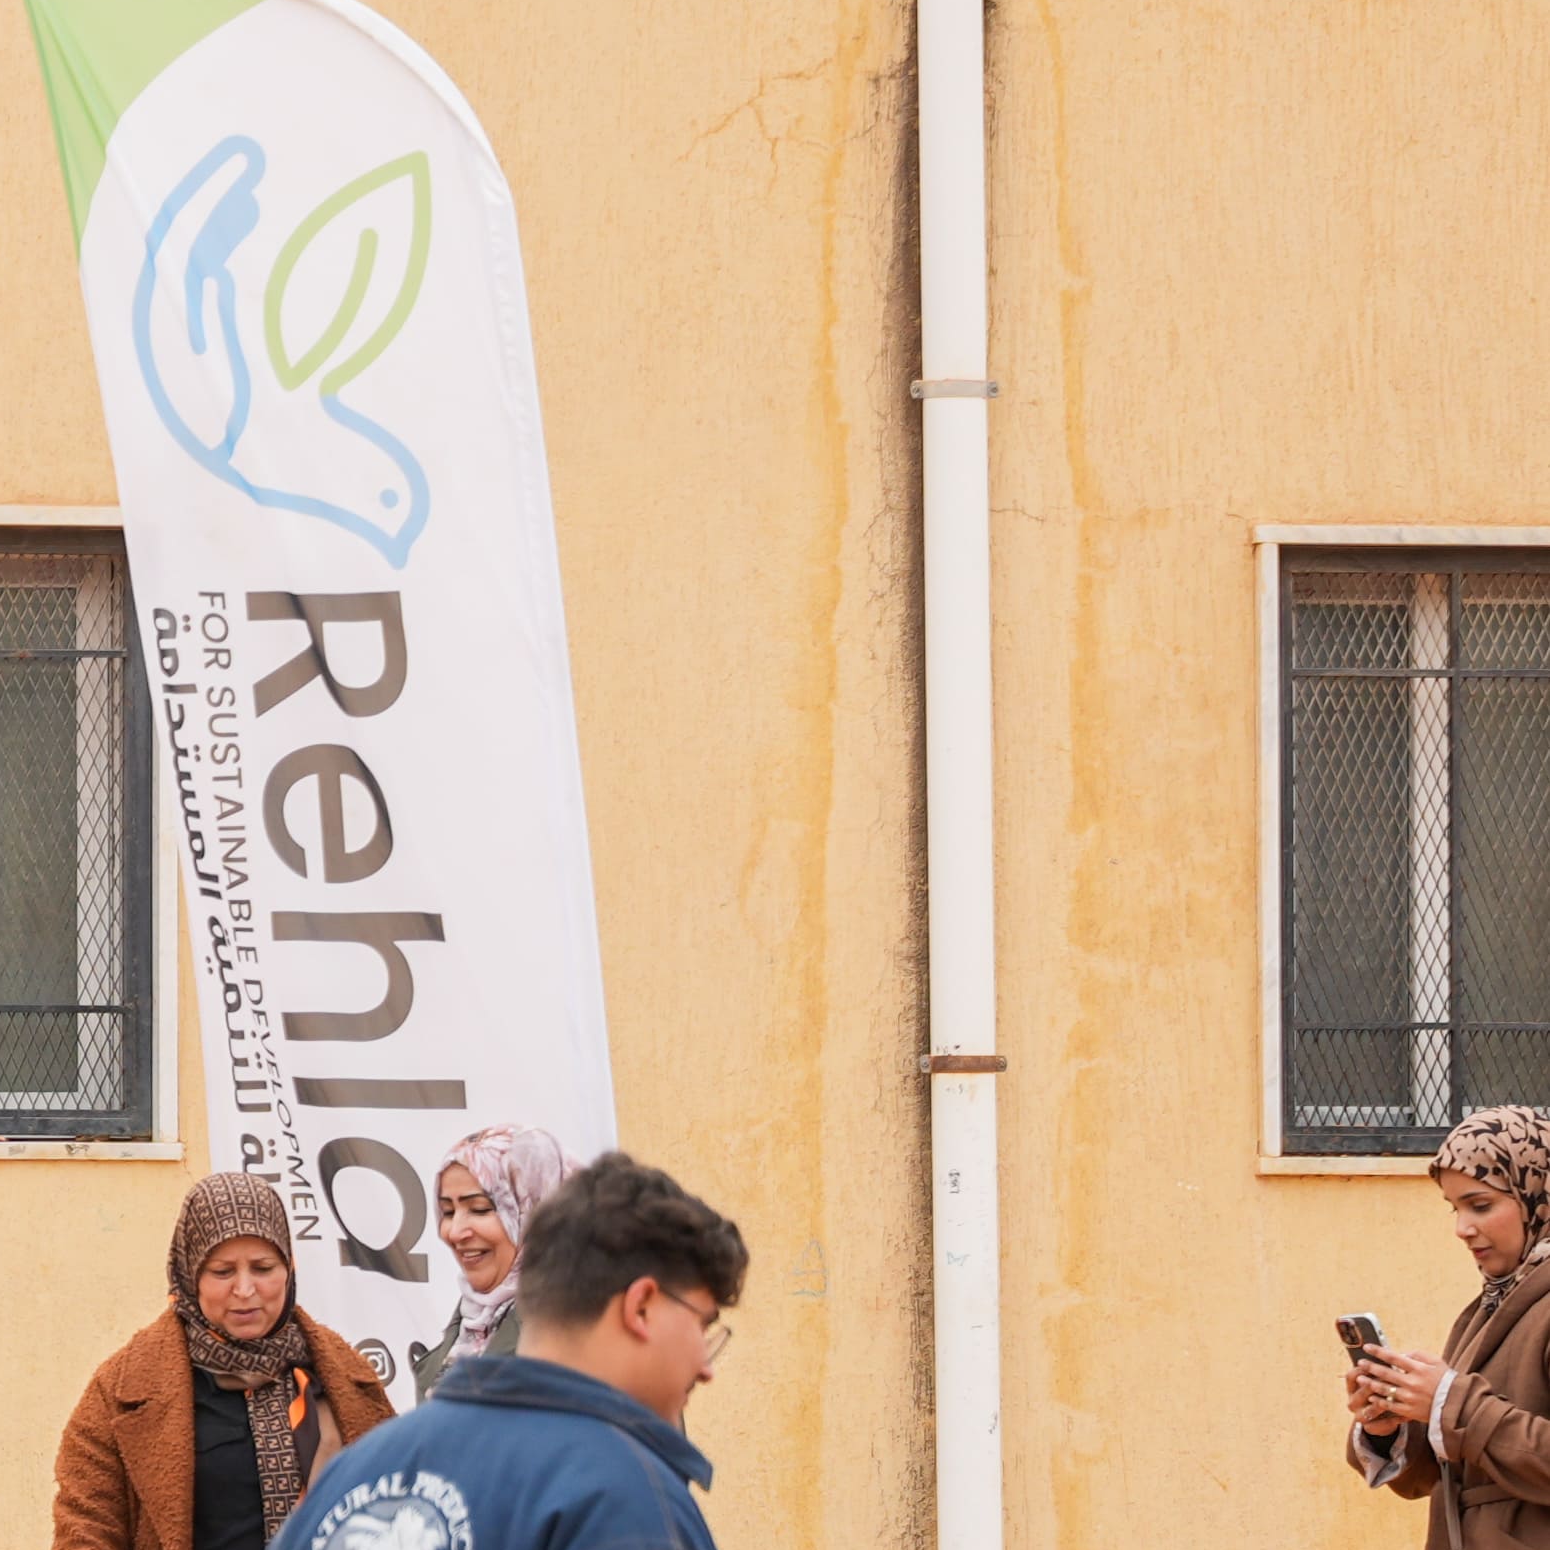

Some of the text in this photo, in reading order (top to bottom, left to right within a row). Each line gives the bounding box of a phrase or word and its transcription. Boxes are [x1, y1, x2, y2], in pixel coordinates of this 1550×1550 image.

[152, 607, 222, 900] المستدامة
[198, 591, 232, 670] FOR
[206, 686, 259, 965] SUSTAINABLE
[245, 590, 467, 1283] Rehla
[204, 915, 271, 1113] للتنمية
